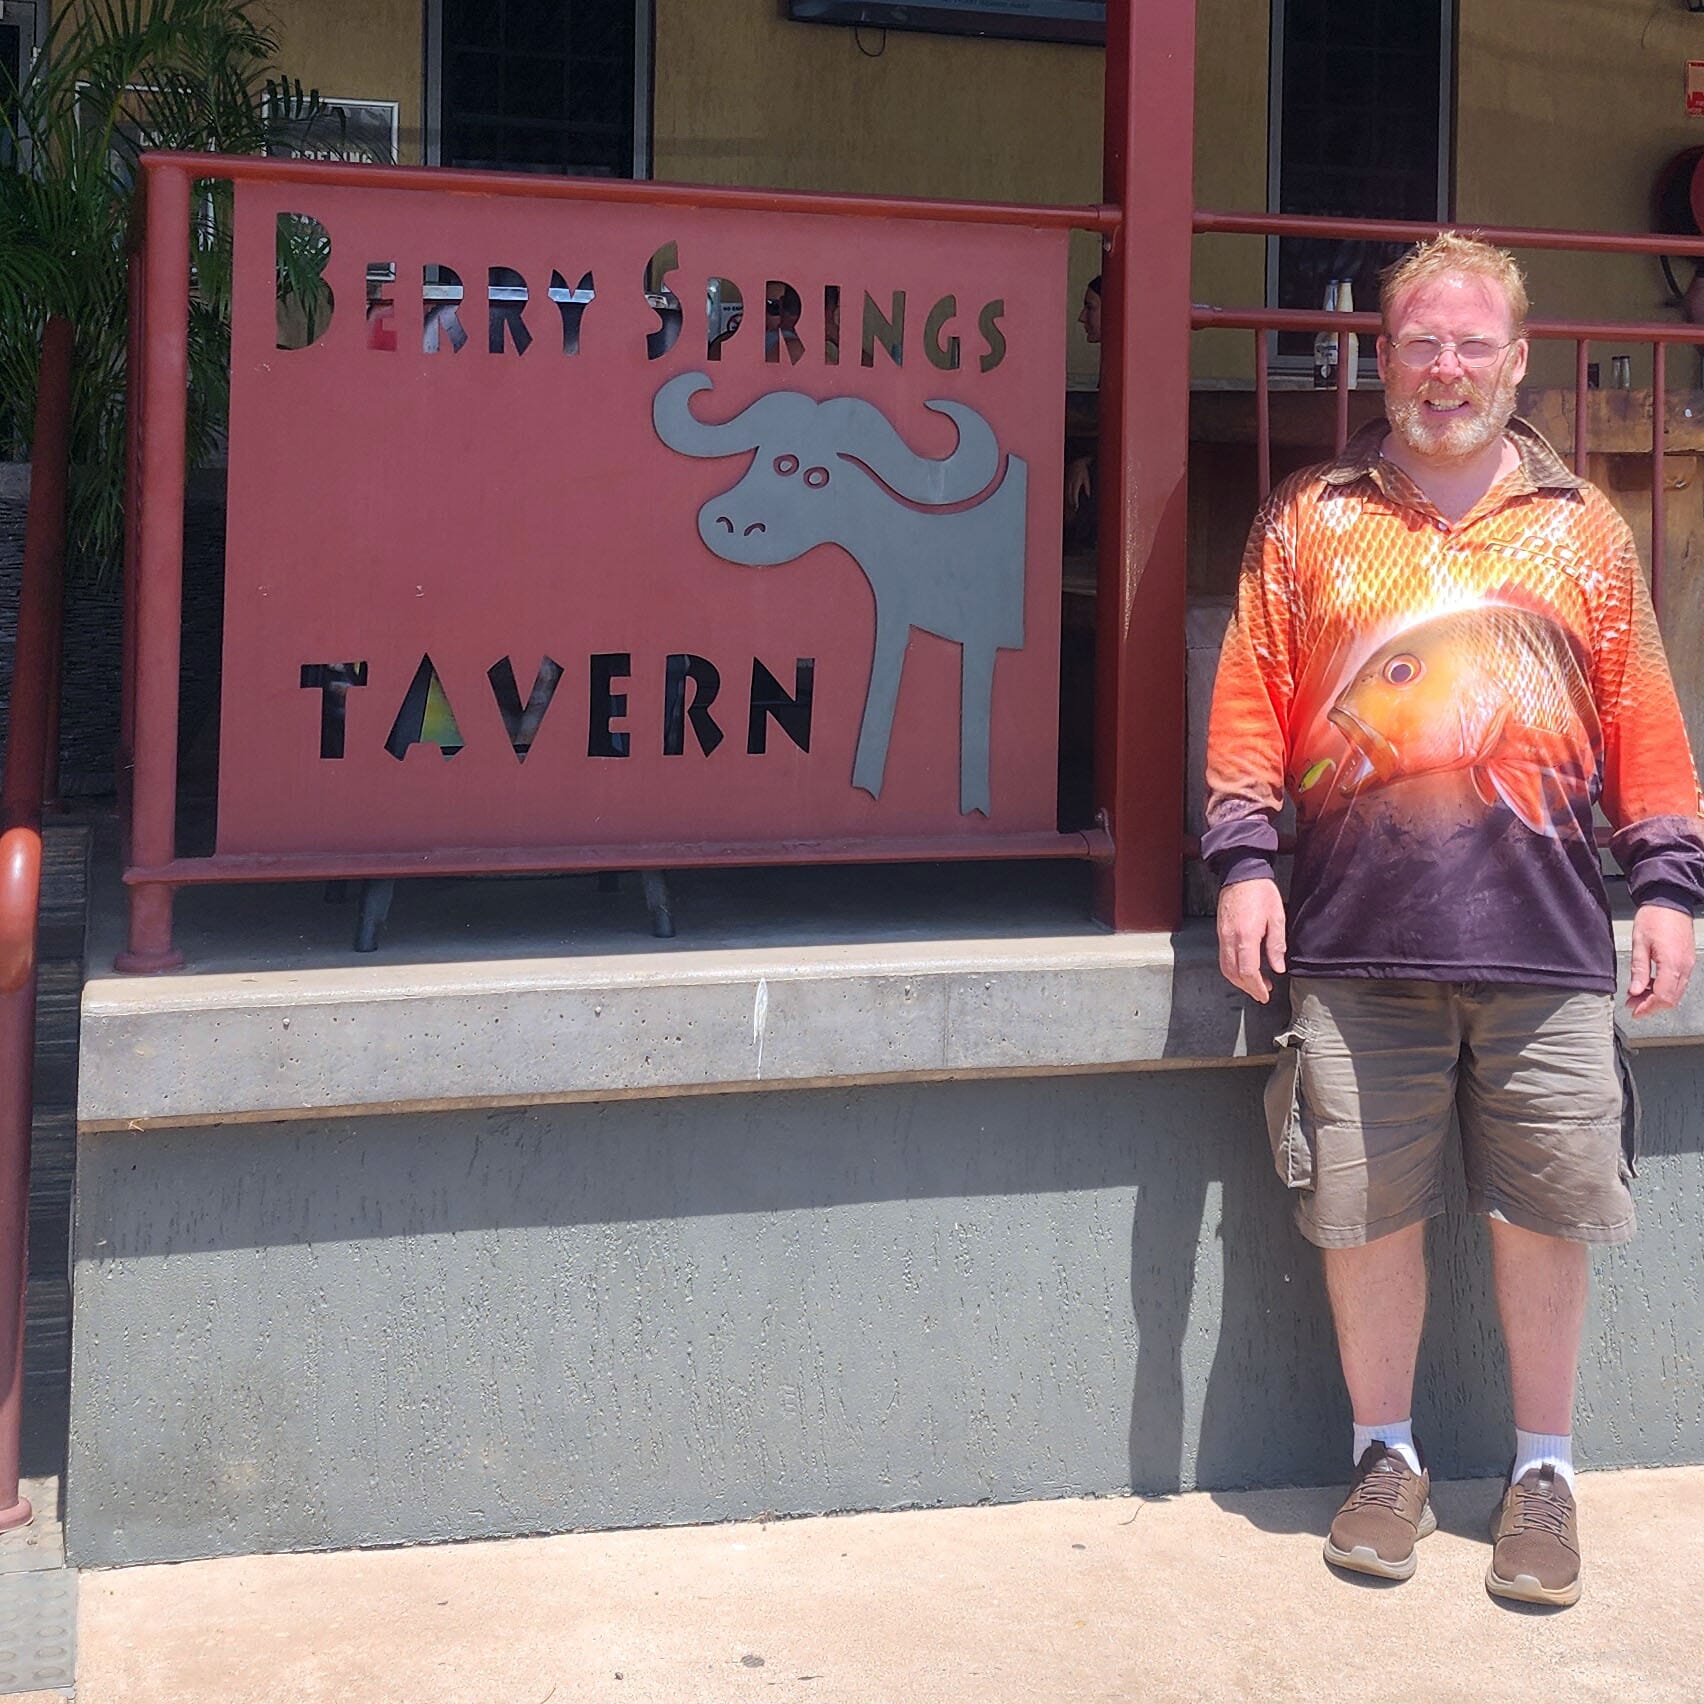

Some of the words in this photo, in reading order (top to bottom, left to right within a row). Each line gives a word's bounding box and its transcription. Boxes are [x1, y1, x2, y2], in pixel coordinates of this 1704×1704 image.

[276, 212, 596, 356] BERRY
[643, 239, 1007, 373] SPRINGS
[300, 652, 815, 764] TAVERN
